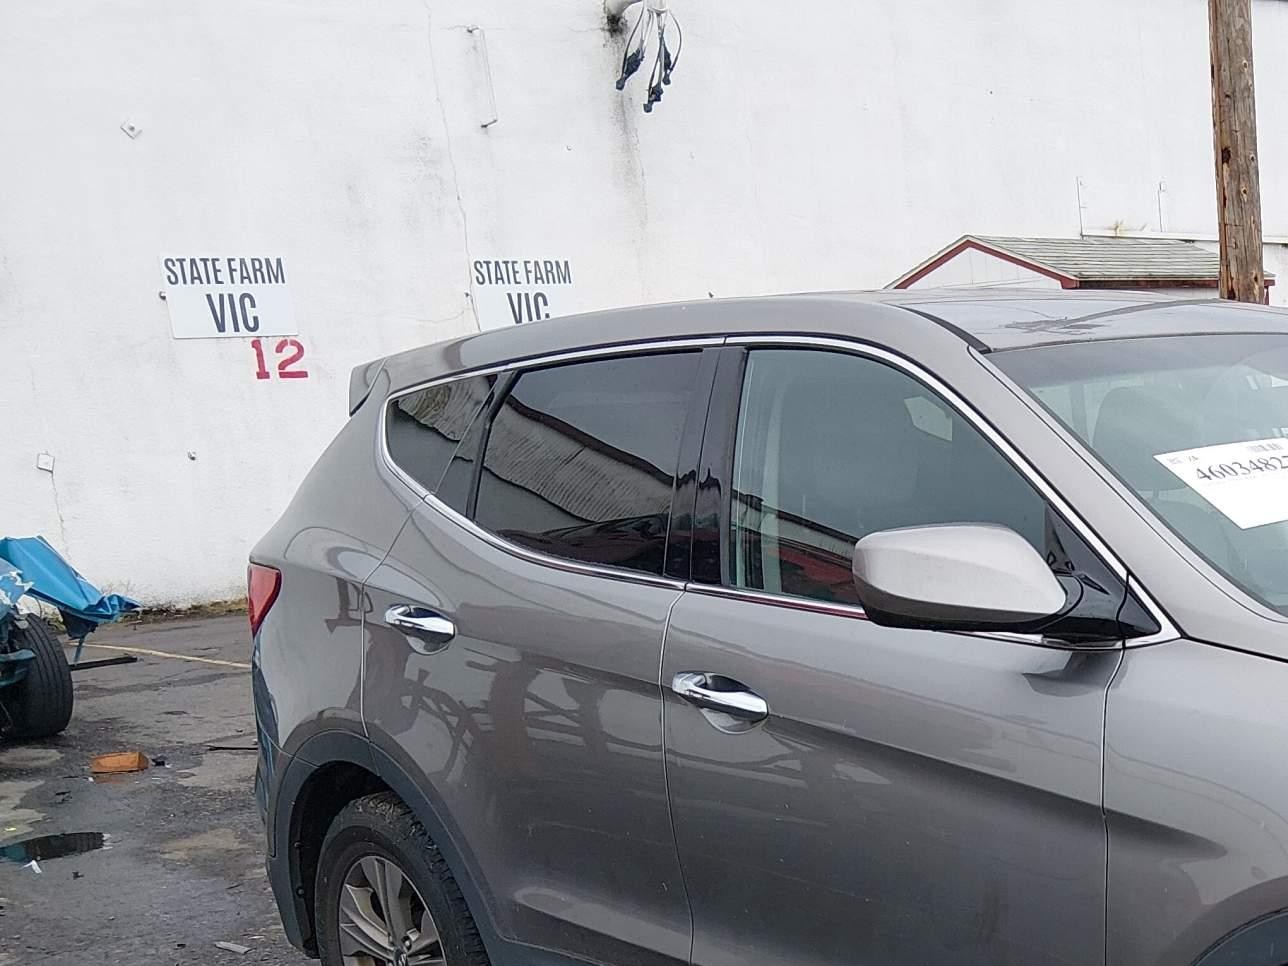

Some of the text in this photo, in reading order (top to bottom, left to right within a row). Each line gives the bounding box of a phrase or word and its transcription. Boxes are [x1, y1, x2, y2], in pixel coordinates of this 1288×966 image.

[164, 257, 286, 285] STATE FARM
[473, 260, 572, 285] STATE FARM
[205, 292, 260, 333] VIC
[506, 292, 551, 324] VIC
[251, 338, 309, 380] 12
